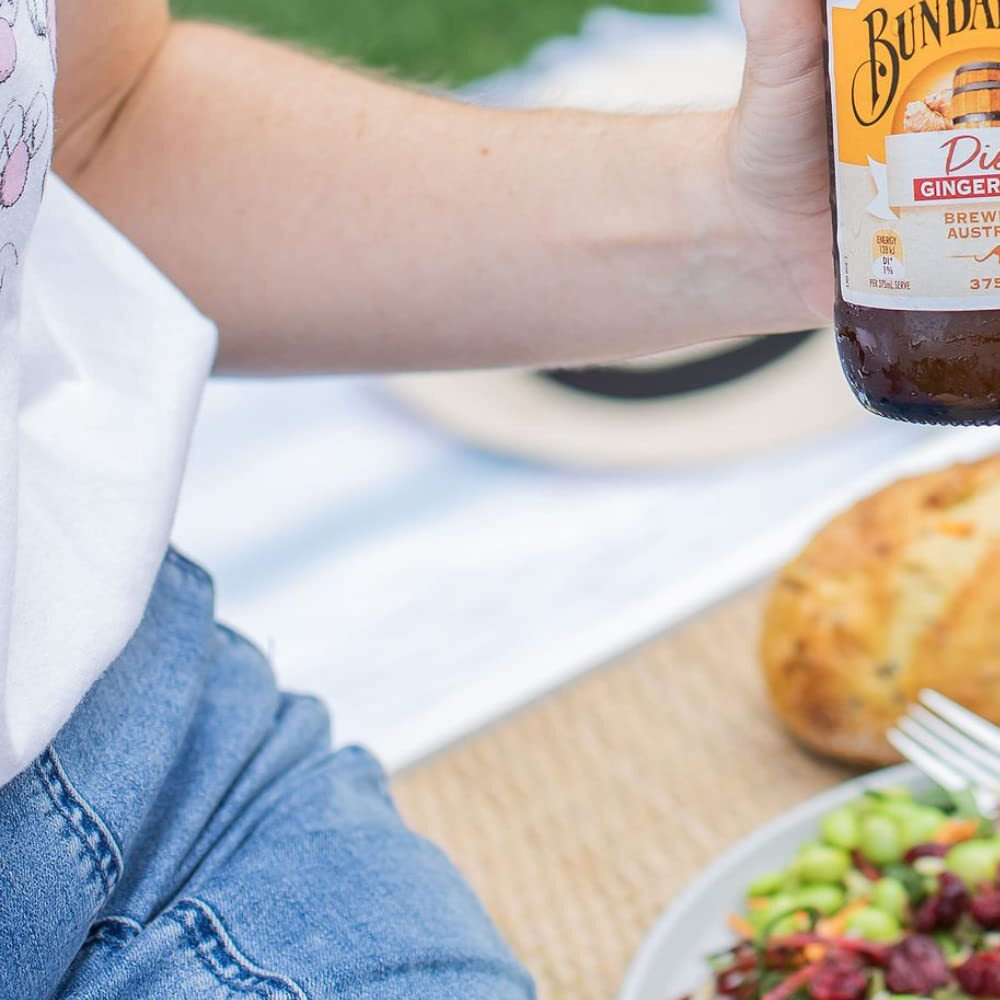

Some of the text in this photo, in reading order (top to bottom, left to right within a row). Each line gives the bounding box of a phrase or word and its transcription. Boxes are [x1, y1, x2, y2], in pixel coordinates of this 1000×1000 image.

[920, 177, 1000, 198] GINGER
[876, 235, 897, 245] ENERGY
[894, 280, 911, 290] SERVE
